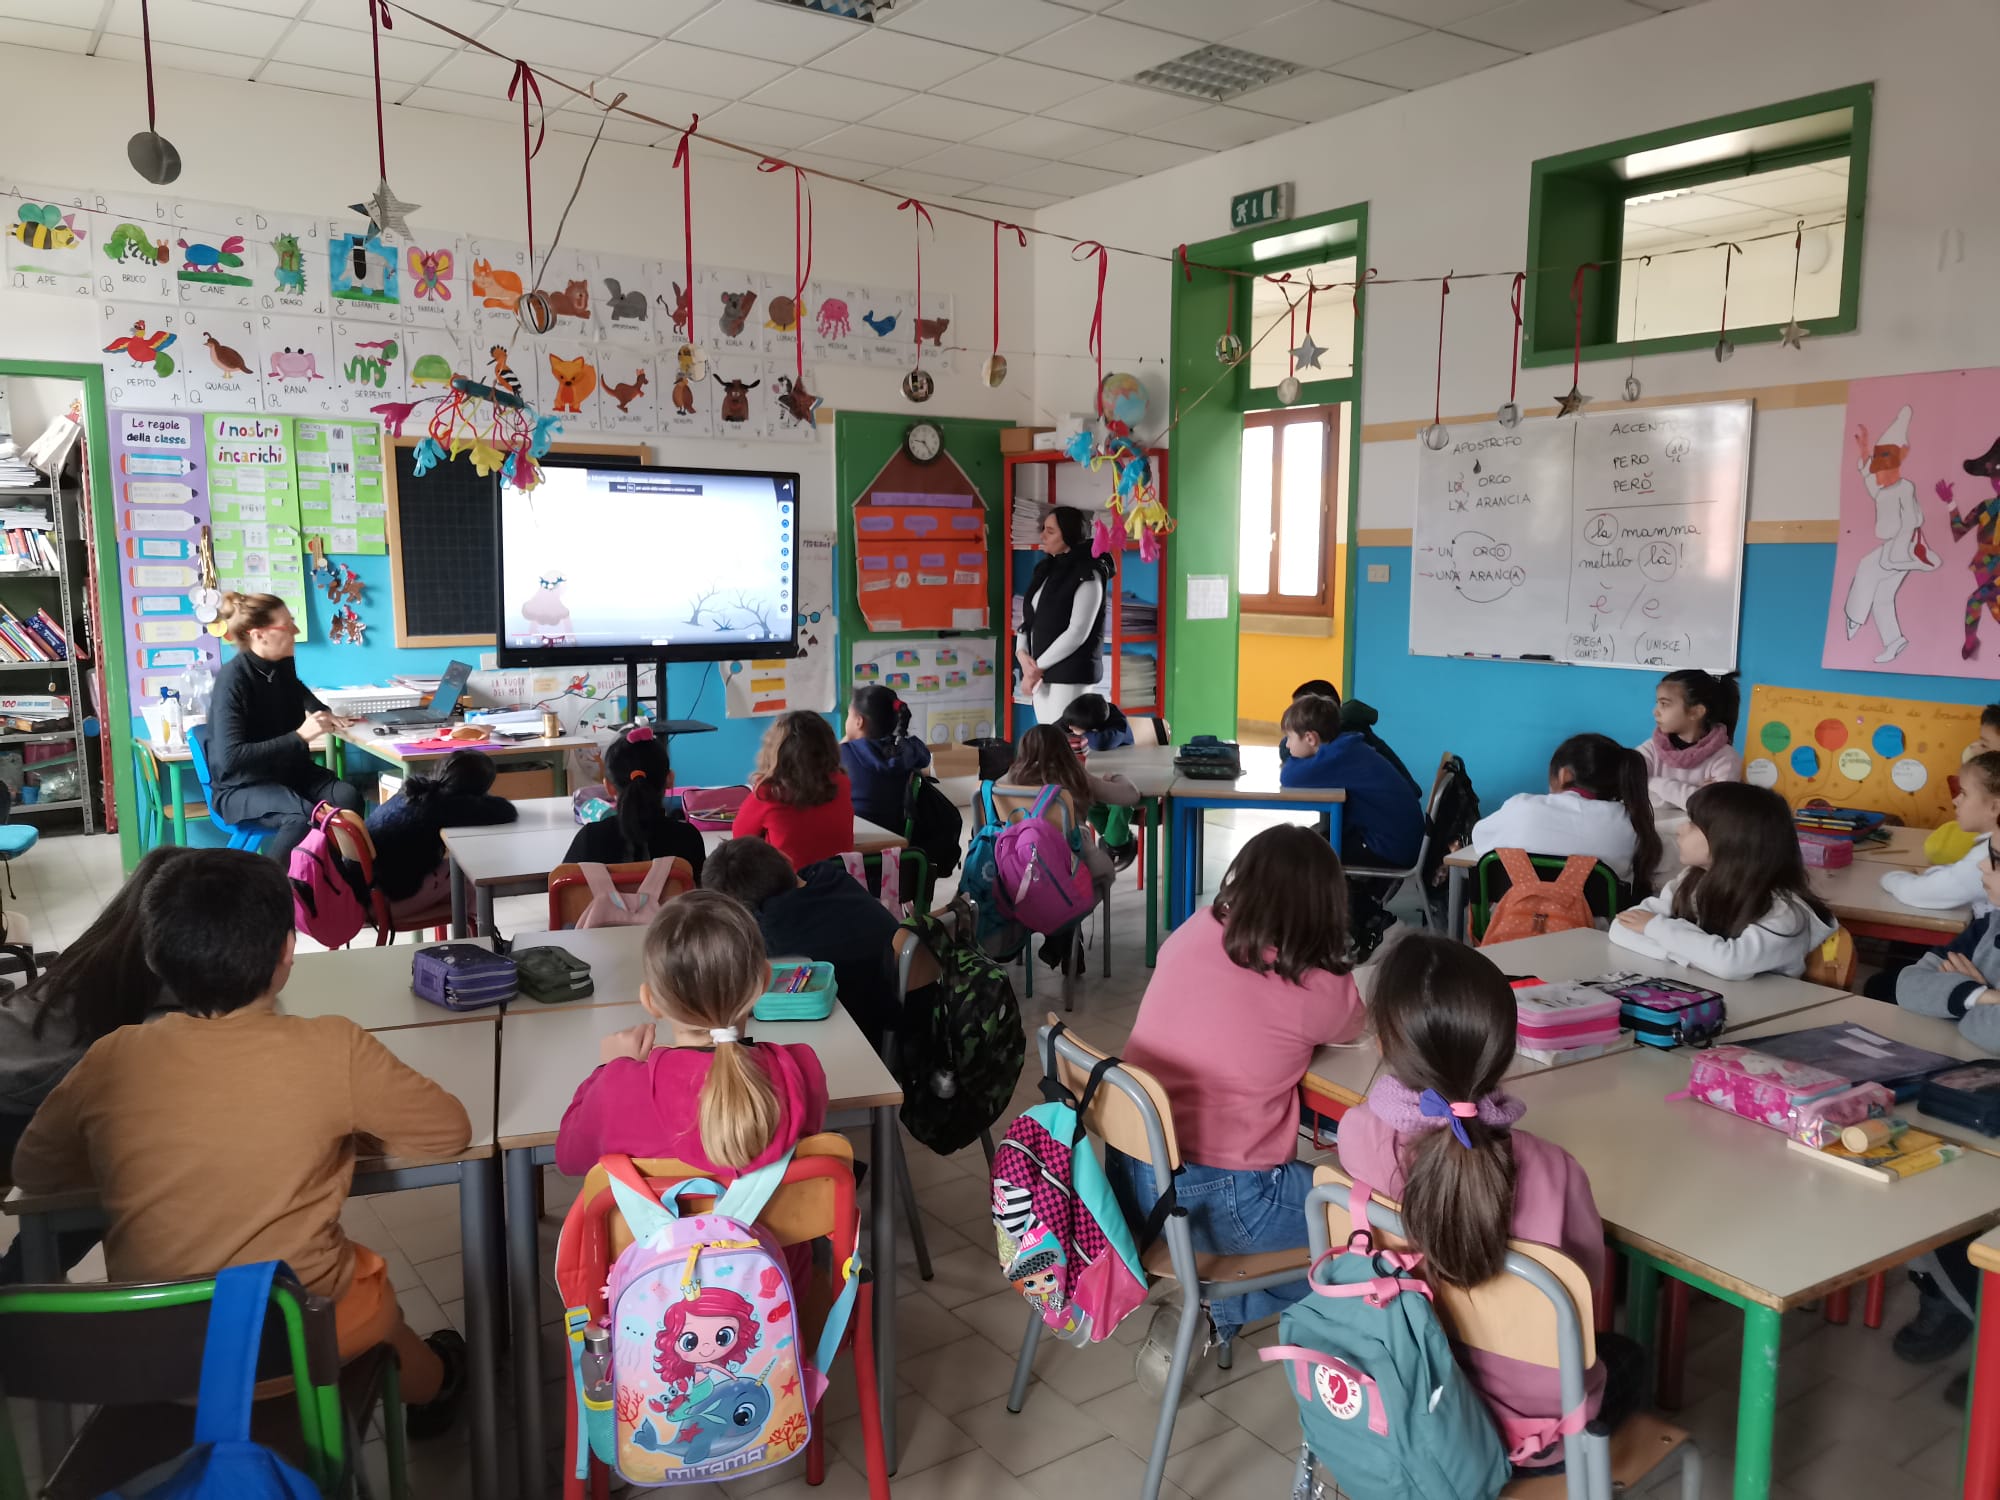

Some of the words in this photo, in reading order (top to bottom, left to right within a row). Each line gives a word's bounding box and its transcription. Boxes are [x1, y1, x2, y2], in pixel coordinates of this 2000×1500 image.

[96, 196, 108, 214] B
[157, 200, 165, 218] b
[174, 204, 184, 219] C
[255, 214, 268, 230] D
[308, 222, 317, 238] d
[329, 222, 338, 237] E
[37, 275, 57, 286] APE
[122, 273, 147, 284] BRUCO
[200, 285, 226, 295] CANE
[280, 297, 303, 307] DRAGO
[351, 300, 381, 311] ELEFANTE
[105, 305, 115, 320] P
[184, 311, 197, 326] Q
[488, 311, 511, 320] GATTO
[165, 315, 173, 328] p
[262, 316, 271, 330] R
[127, 379, 156, 388] PEPITO
[205, 383, 241, 392] QUAGLIA
[284, 385, 308, 394] RANA
[354, 390, 392, 399] SERPENTE
[132, 418, 145, 428] Le
[148, 419, 180, 432] regole
[219, 421, 225, 436] I
[229, 421, 279, 438] nostri
[126, 433, 151, 443] della
[154, 433, 187, 445] classe
[1453, 436, 1523, 455] APOSTROFO
[218, 445, 282, 464] incarichi
[1613, 454, 1650, 470] PERO
[1478, 474, 1512, 487] ORCO
[1476, 494, 1531, 508] ARANCIA
[1591, 518, 1612, 540] la
[1621, 525, 1701, 538] mamma
[1438, 547, 1453, 558] UN
[1473, 546, 1506, 558] ORCO
[1469, 568, 1520, 582] ARANCIA
[2, 700, 17, 708] 100
[667, 1446, 764, 1480] MITAMA
